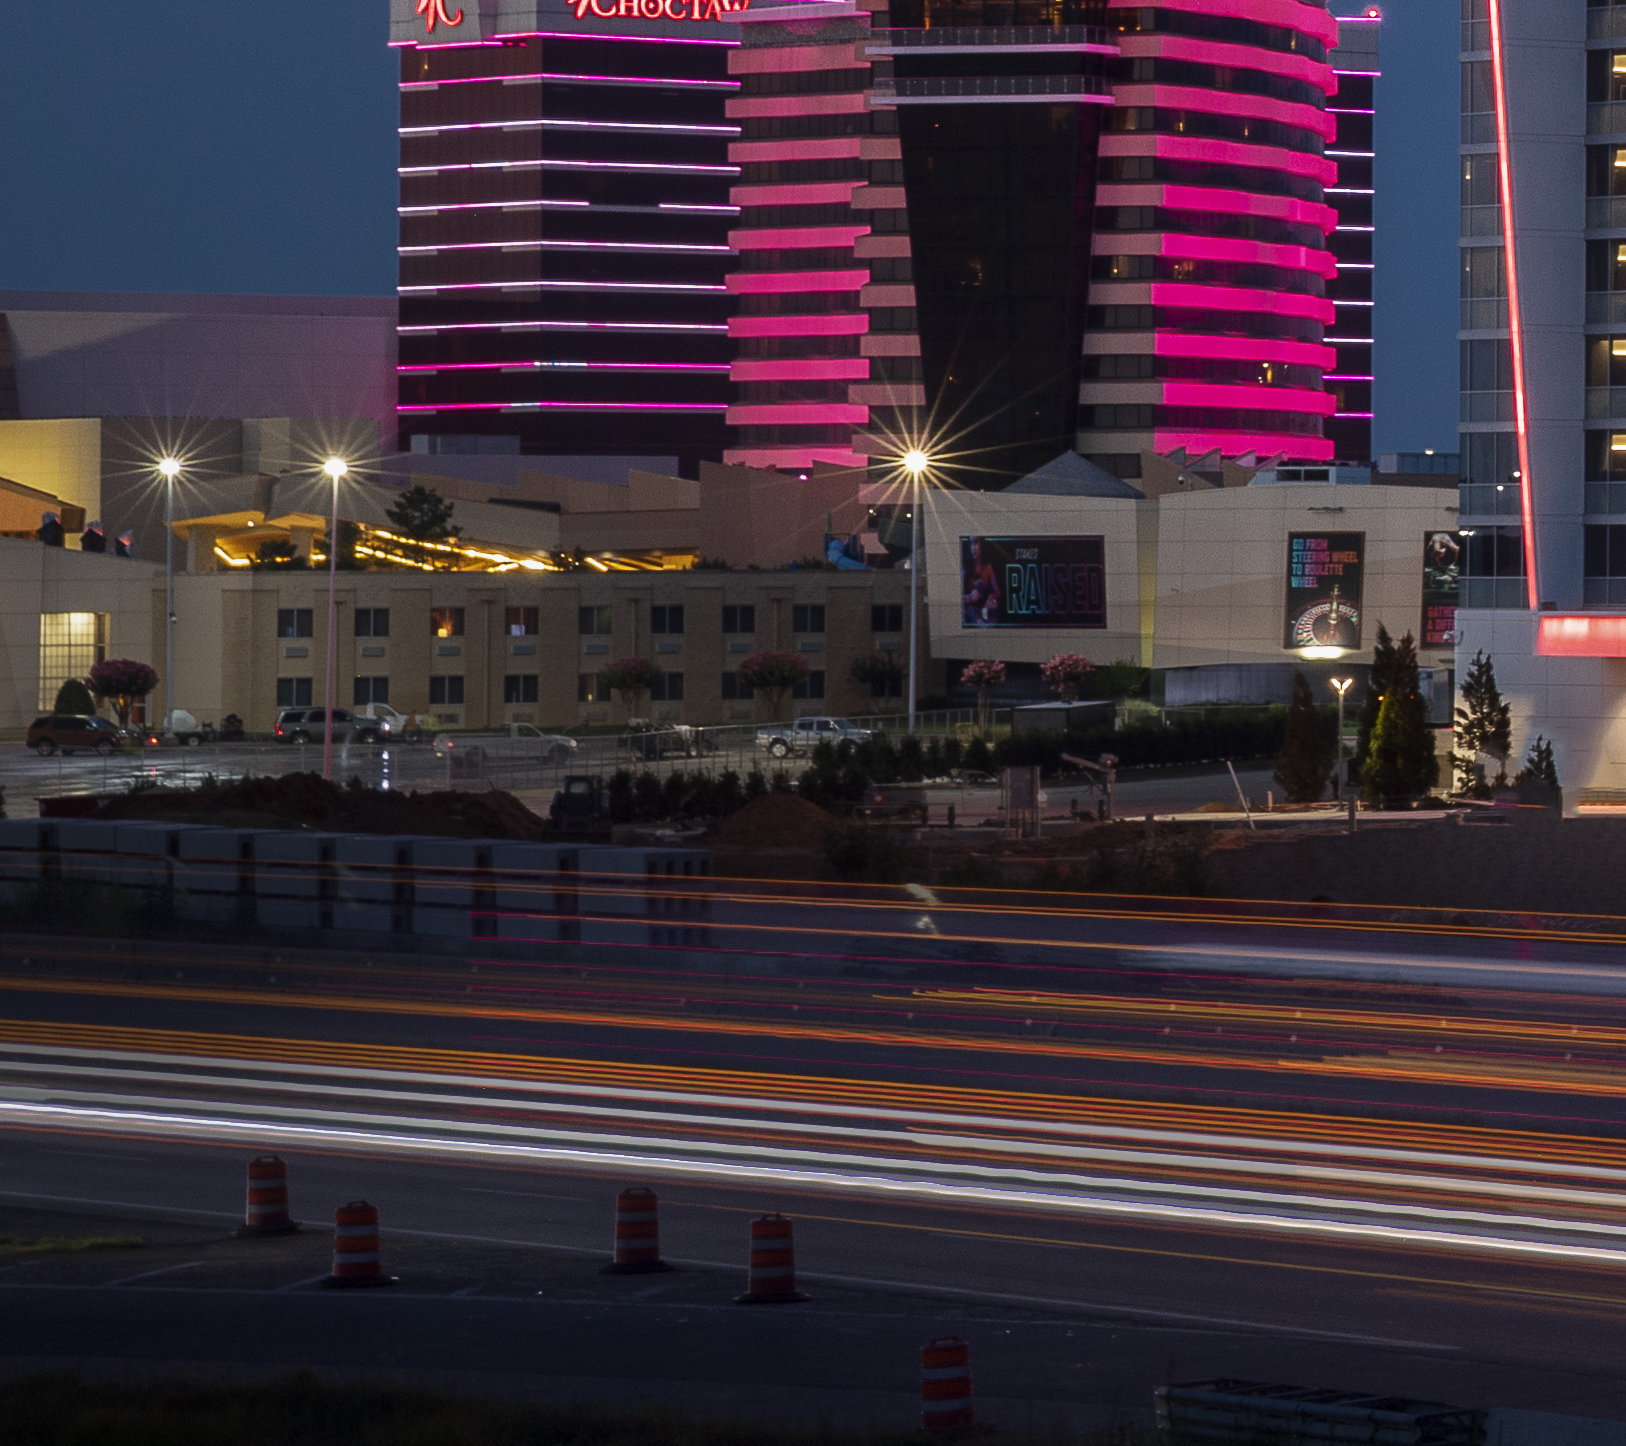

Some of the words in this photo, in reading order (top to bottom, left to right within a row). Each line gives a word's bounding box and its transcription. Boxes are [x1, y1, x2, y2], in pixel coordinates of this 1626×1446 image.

[1306, 538, 1328, 550] FROM
[1292, 564, 1303, 575] TO
[1006, 563, 1105, 614] RAISED
